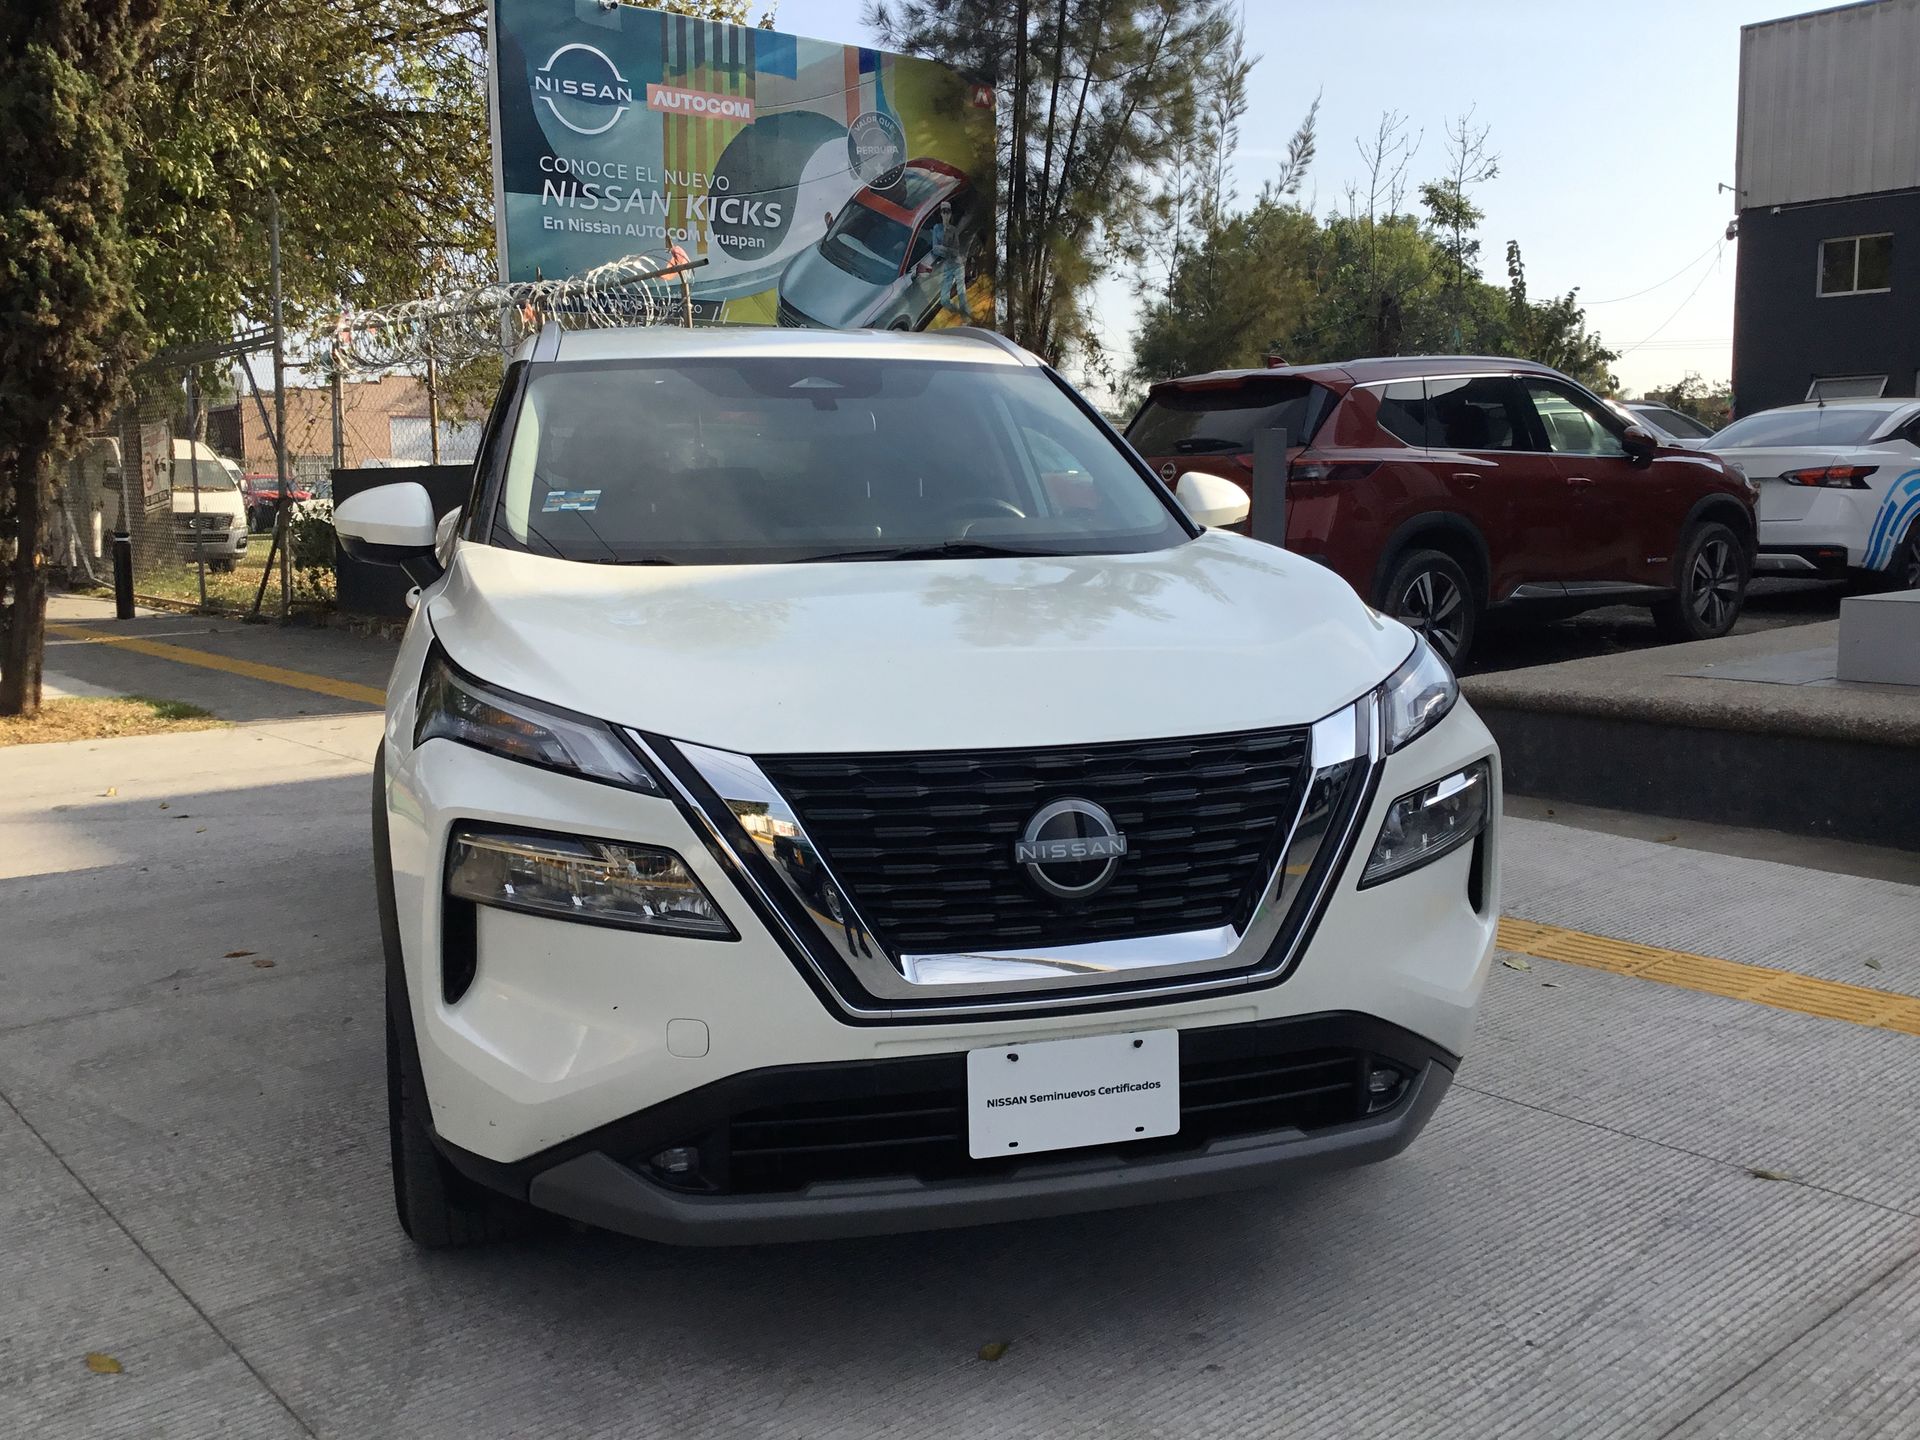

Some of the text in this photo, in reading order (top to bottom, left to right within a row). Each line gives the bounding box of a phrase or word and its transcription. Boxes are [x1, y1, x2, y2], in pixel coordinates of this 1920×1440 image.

[535, 75, 633, 102] NISSAN
[653, 90, 750, 118] AUTOCOM
[854, 115, 895, 132] VALOR QUE
[856, 145, 899, 155] PERDURA
[539, 155, 730, 191] CONOCE EL NUEVO
[541, 178, 783, 228] NISSAN KICKS
[543, 216, 766, 249] En Nissan AUTOCOM Uruapan
[1019, 838, 1124, 860] NISSAN
[986, 1080, 1161, 1108] NISSAN Seminuevos Certificados
